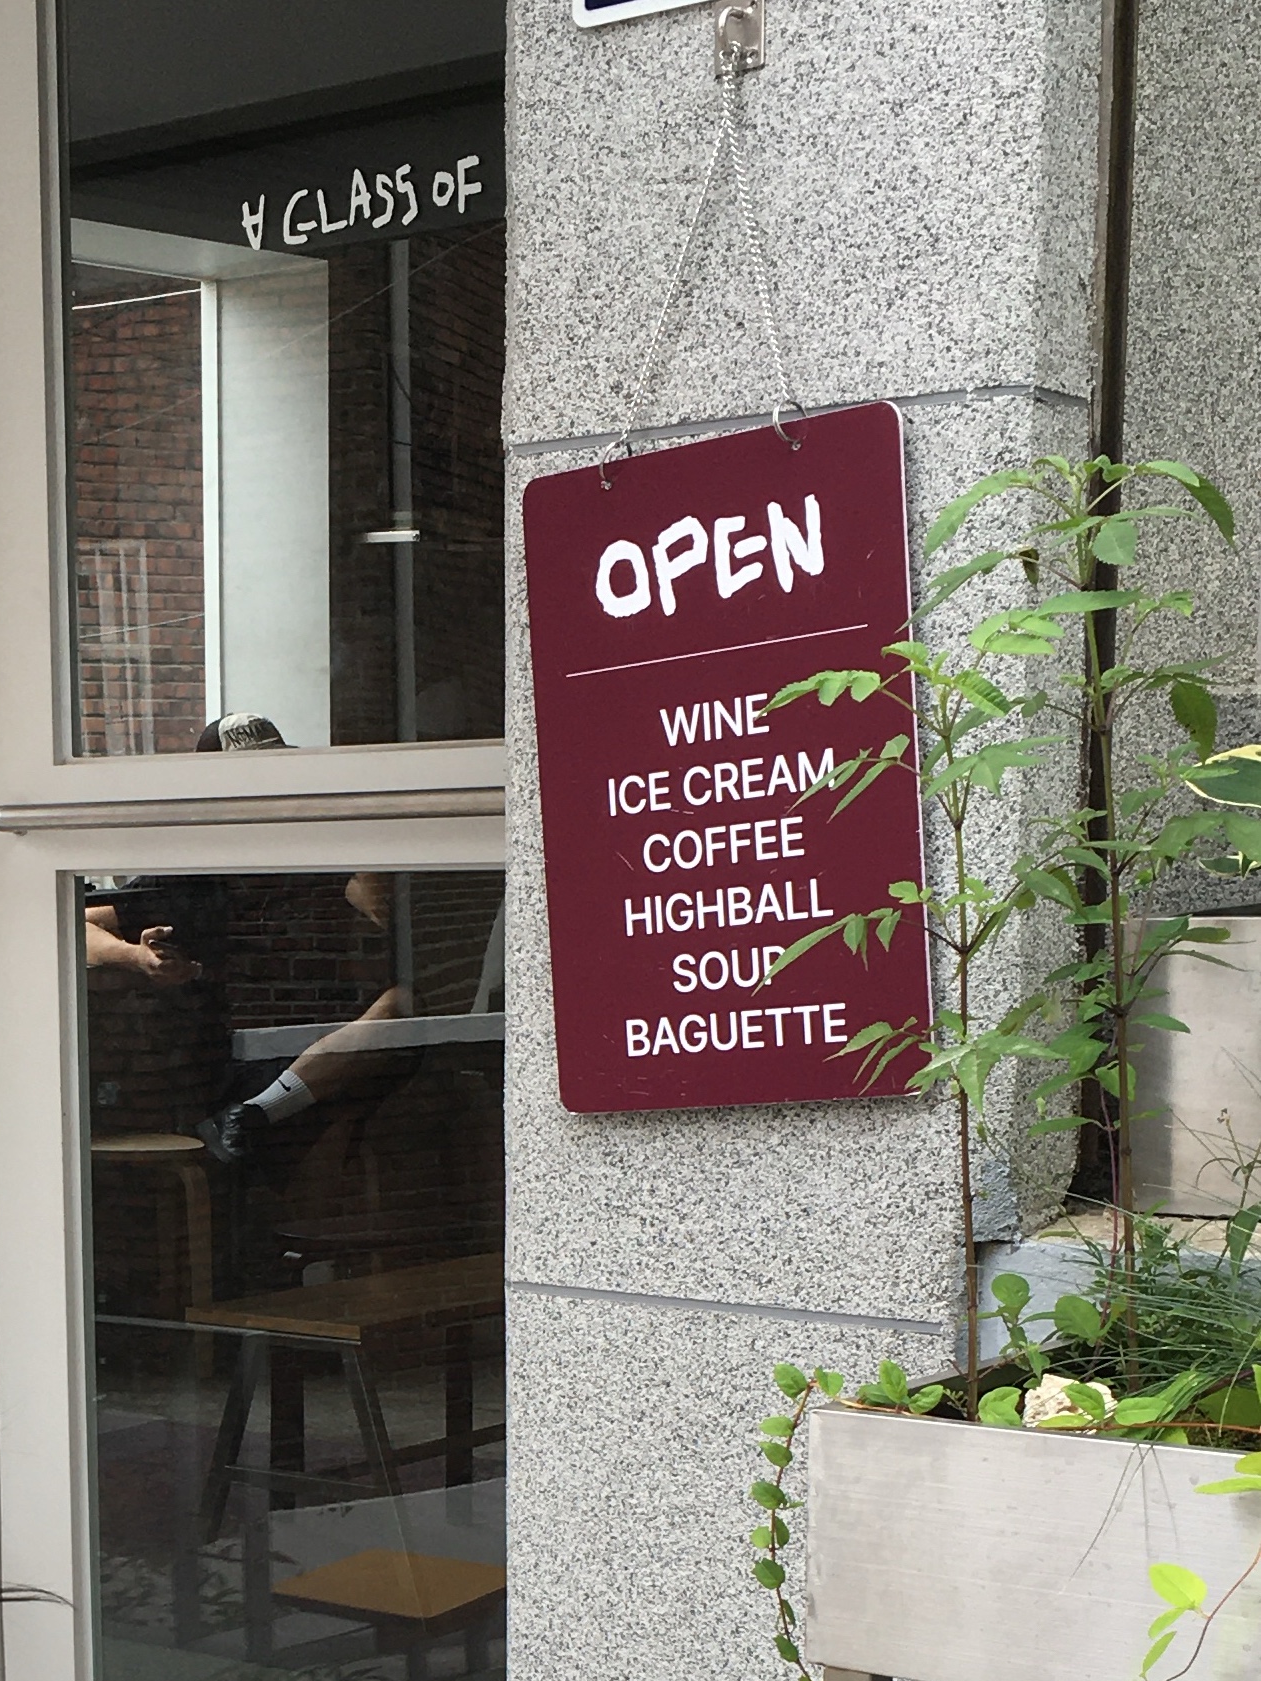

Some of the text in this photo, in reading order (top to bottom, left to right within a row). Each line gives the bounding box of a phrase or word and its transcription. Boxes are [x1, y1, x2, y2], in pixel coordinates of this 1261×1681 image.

[432, 154, 483, 214] OF
[595, 494, 825, 618] OPEN
[659, 693, 770, 747] WINE
[607, 747, 836, 817] ICE CREAM
[643, 816, 806, 874] COFFEE
[624, 878, 835, 937] HIGHBALL
[625, 1003, 849, 1058] BAGUETTE
